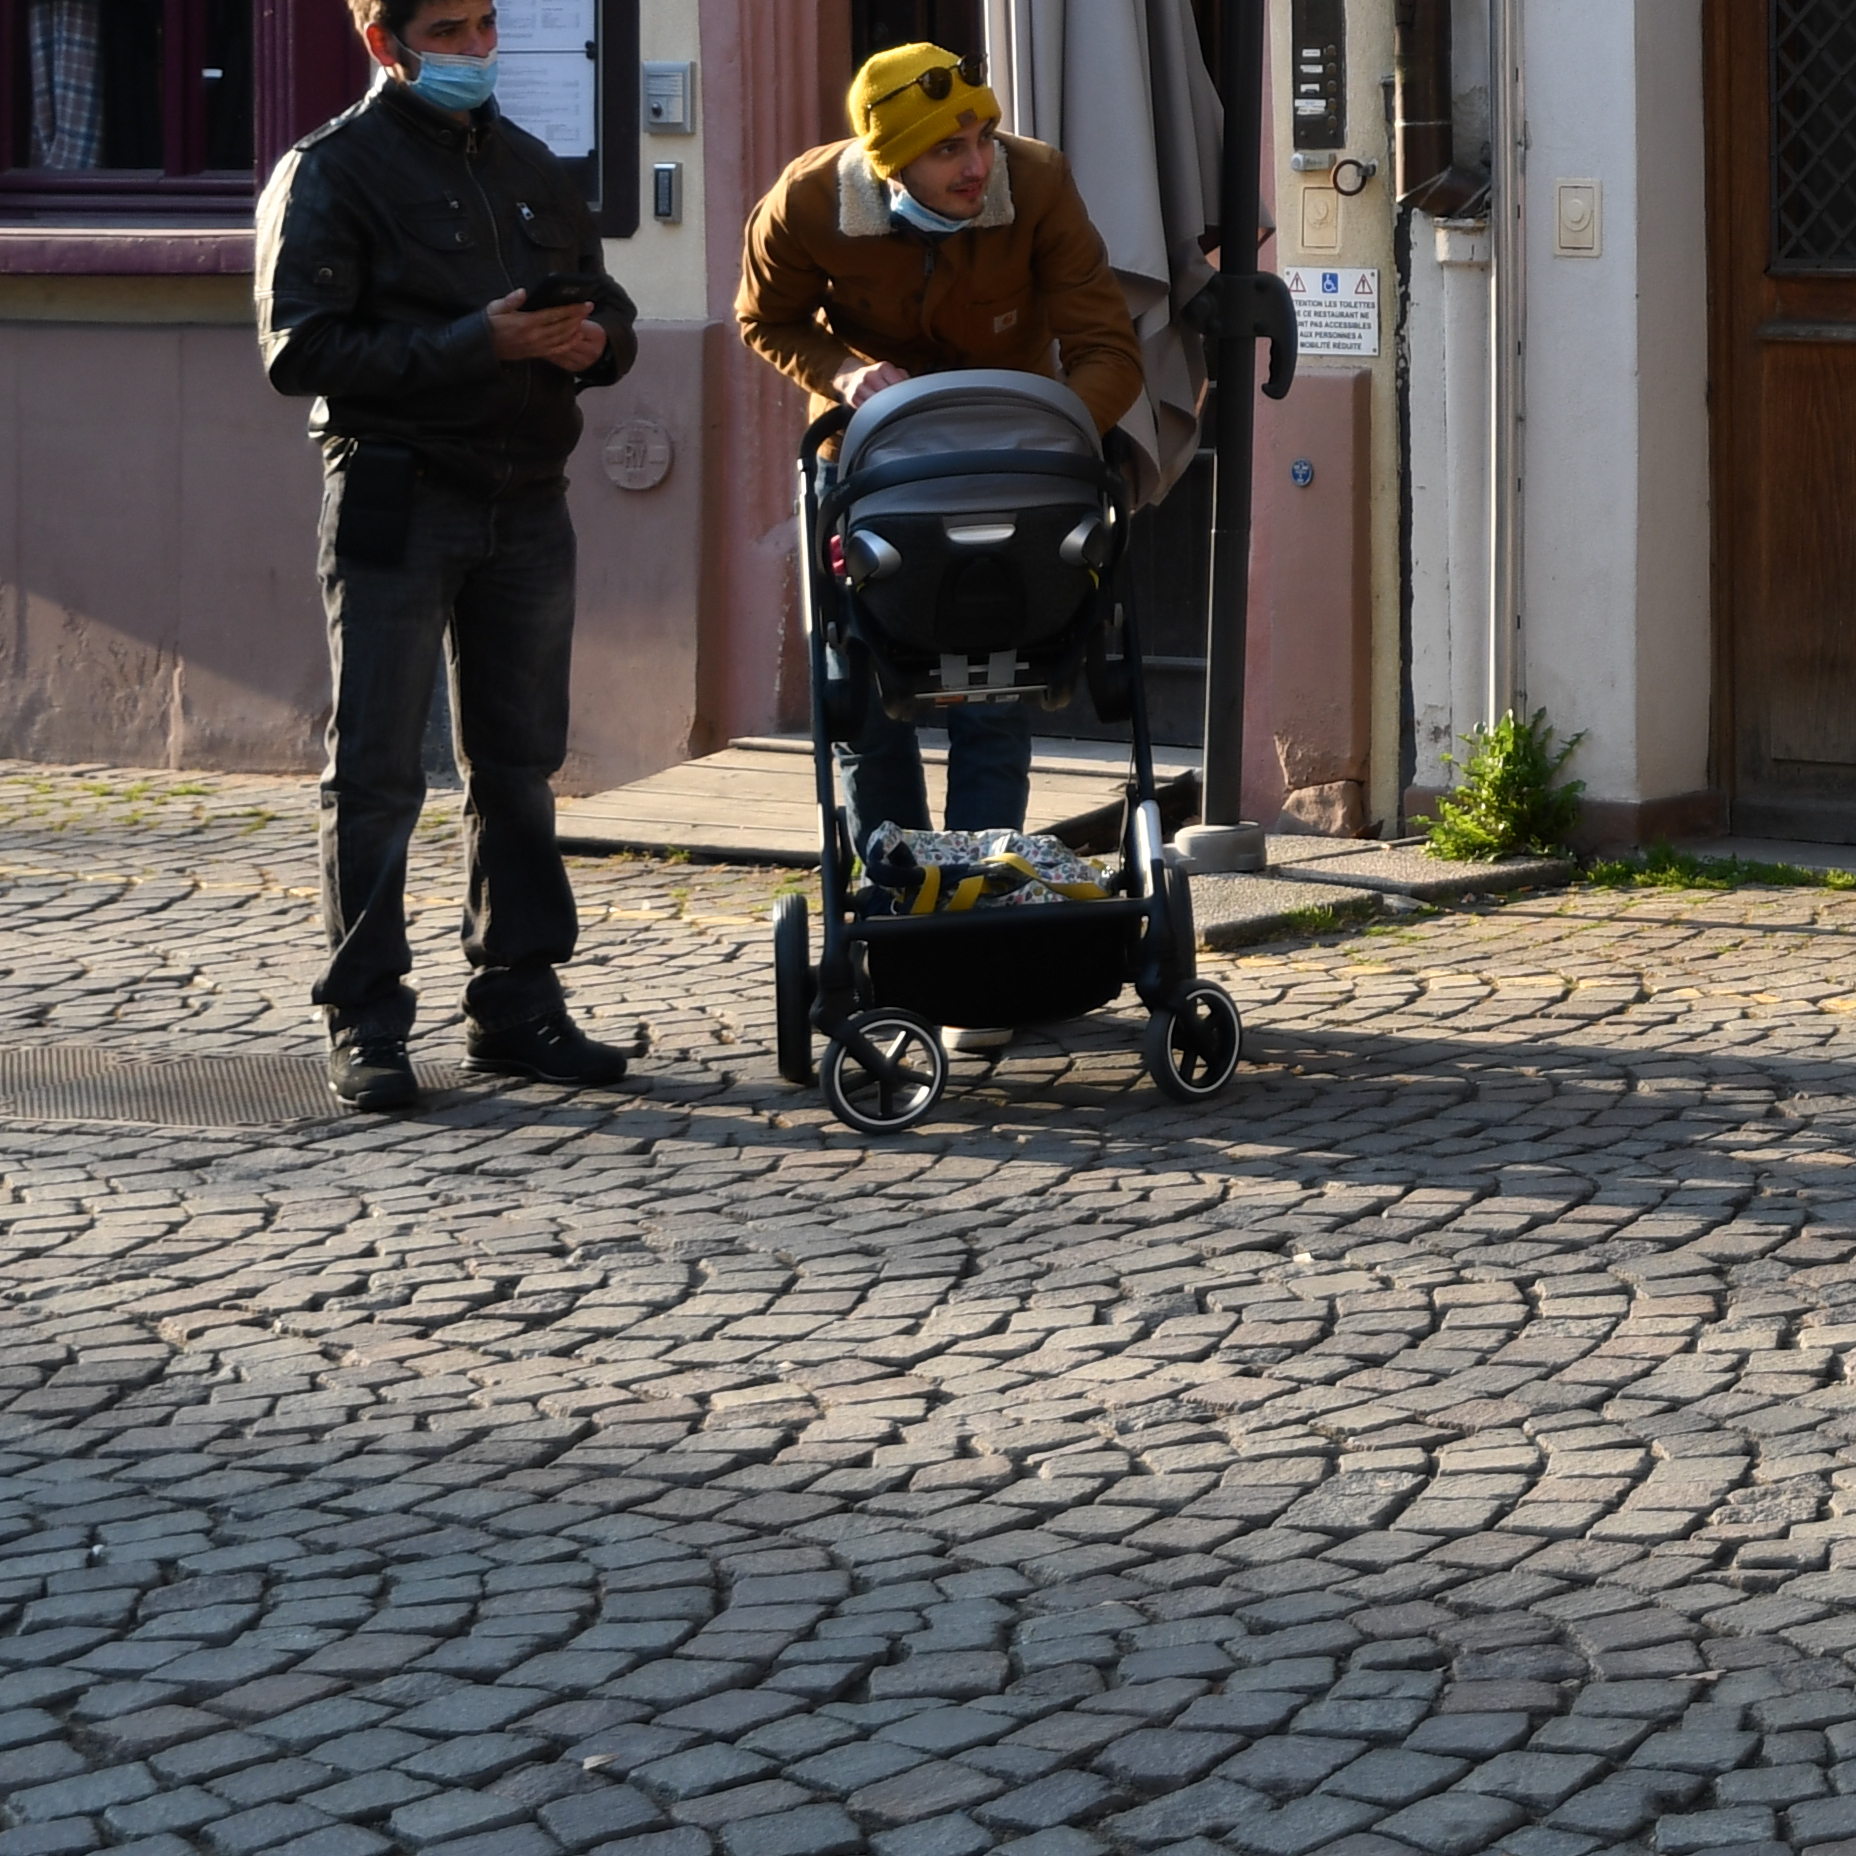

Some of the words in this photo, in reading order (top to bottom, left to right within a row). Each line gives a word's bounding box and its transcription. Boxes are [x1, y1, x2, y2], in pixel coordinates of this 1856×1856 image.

[1294, 299, 1323, 308] TENTION
[1324, 300, 1338, 308] LES
[1339, 300, 1376, 309] TOILETTES
[1314, 310, 1359, 318] RESTAURANT
[1324, 321, 1372, 329] ACCESSIBLES
[1315, 331, 1356, 340] PERSONNES
